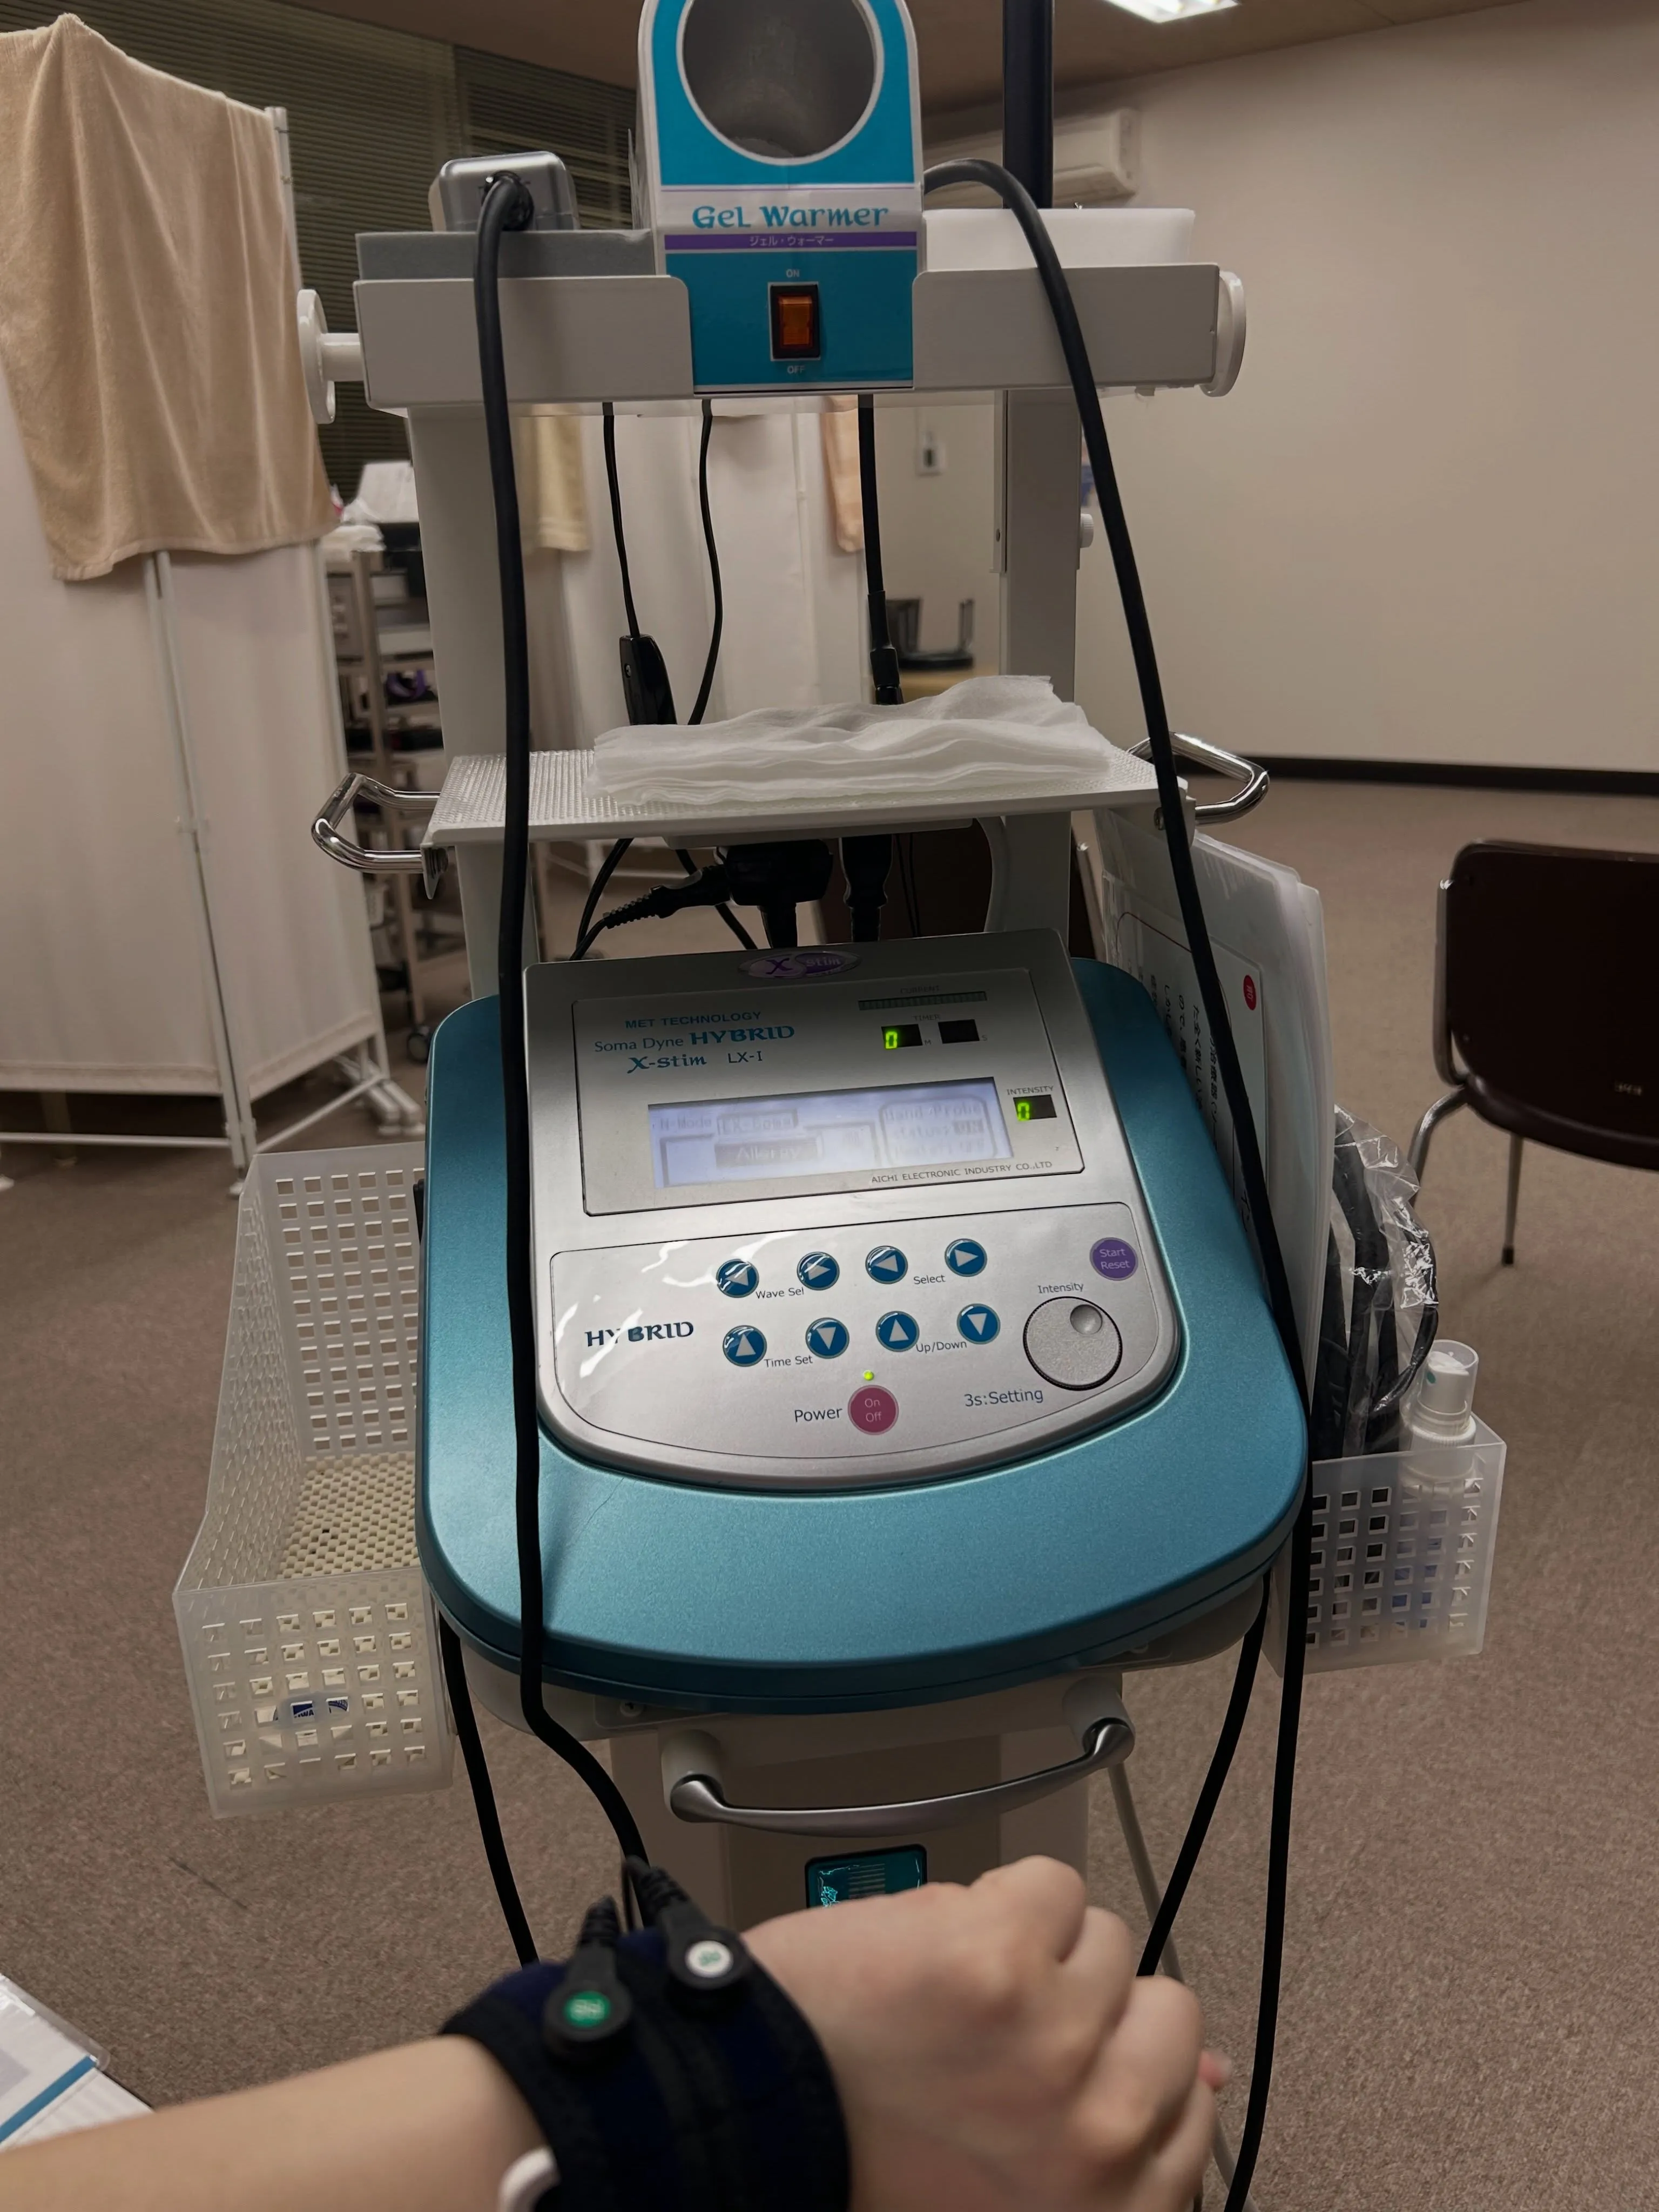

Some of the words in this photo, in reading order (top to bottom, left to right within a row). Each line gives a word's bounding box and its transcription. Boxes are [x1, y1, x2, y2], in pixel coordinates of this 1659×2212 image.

[759, 206, 889, 227] Warmer
[749, 235, 834, 246] ジェル・ウォーマー
[786, 269, 800, 278] ON
[787, 366, 805, 374] OFF
[625, 1019, 655, 1028] MET
[660, 1011, 761, 1026] TECHNOLOGY
[594, 1041, 637, 1052] Soma
[643, 1037, 684, 1051] Dyne
[689, 1025, 795, 1045] HYBRID
[1007, 1085, 1054, 1095] INTENSITY
[872, 1175, 899, 1183] AICHI
[902, 1169, 961, 1181] ELECTRONIC
[965, 1164, 1011, 1175] INDUSTRY
[1100, 1248, 1126, 1258] Start
[1101, 1260, 1130, 1270] Reset
[913, 1274, 946, 1285] Select
[756, 1288, 785, 1299] Wave
[788, 1286, 804, 1297] Sel
[1038, 1283, 1084, 1294] Intensity
[916, 1340, 967, 1354] Up/Down
[764, 1357, 792, 1368] Time
[795, 1354, 813, 1365] Set
[964, 1388, 1043, 1407] 3s:Setting
[865, 1399, 880, 1408] On
[794, 1407, 843, 1422] Power
[865, 1411, 882, 1422] Off
